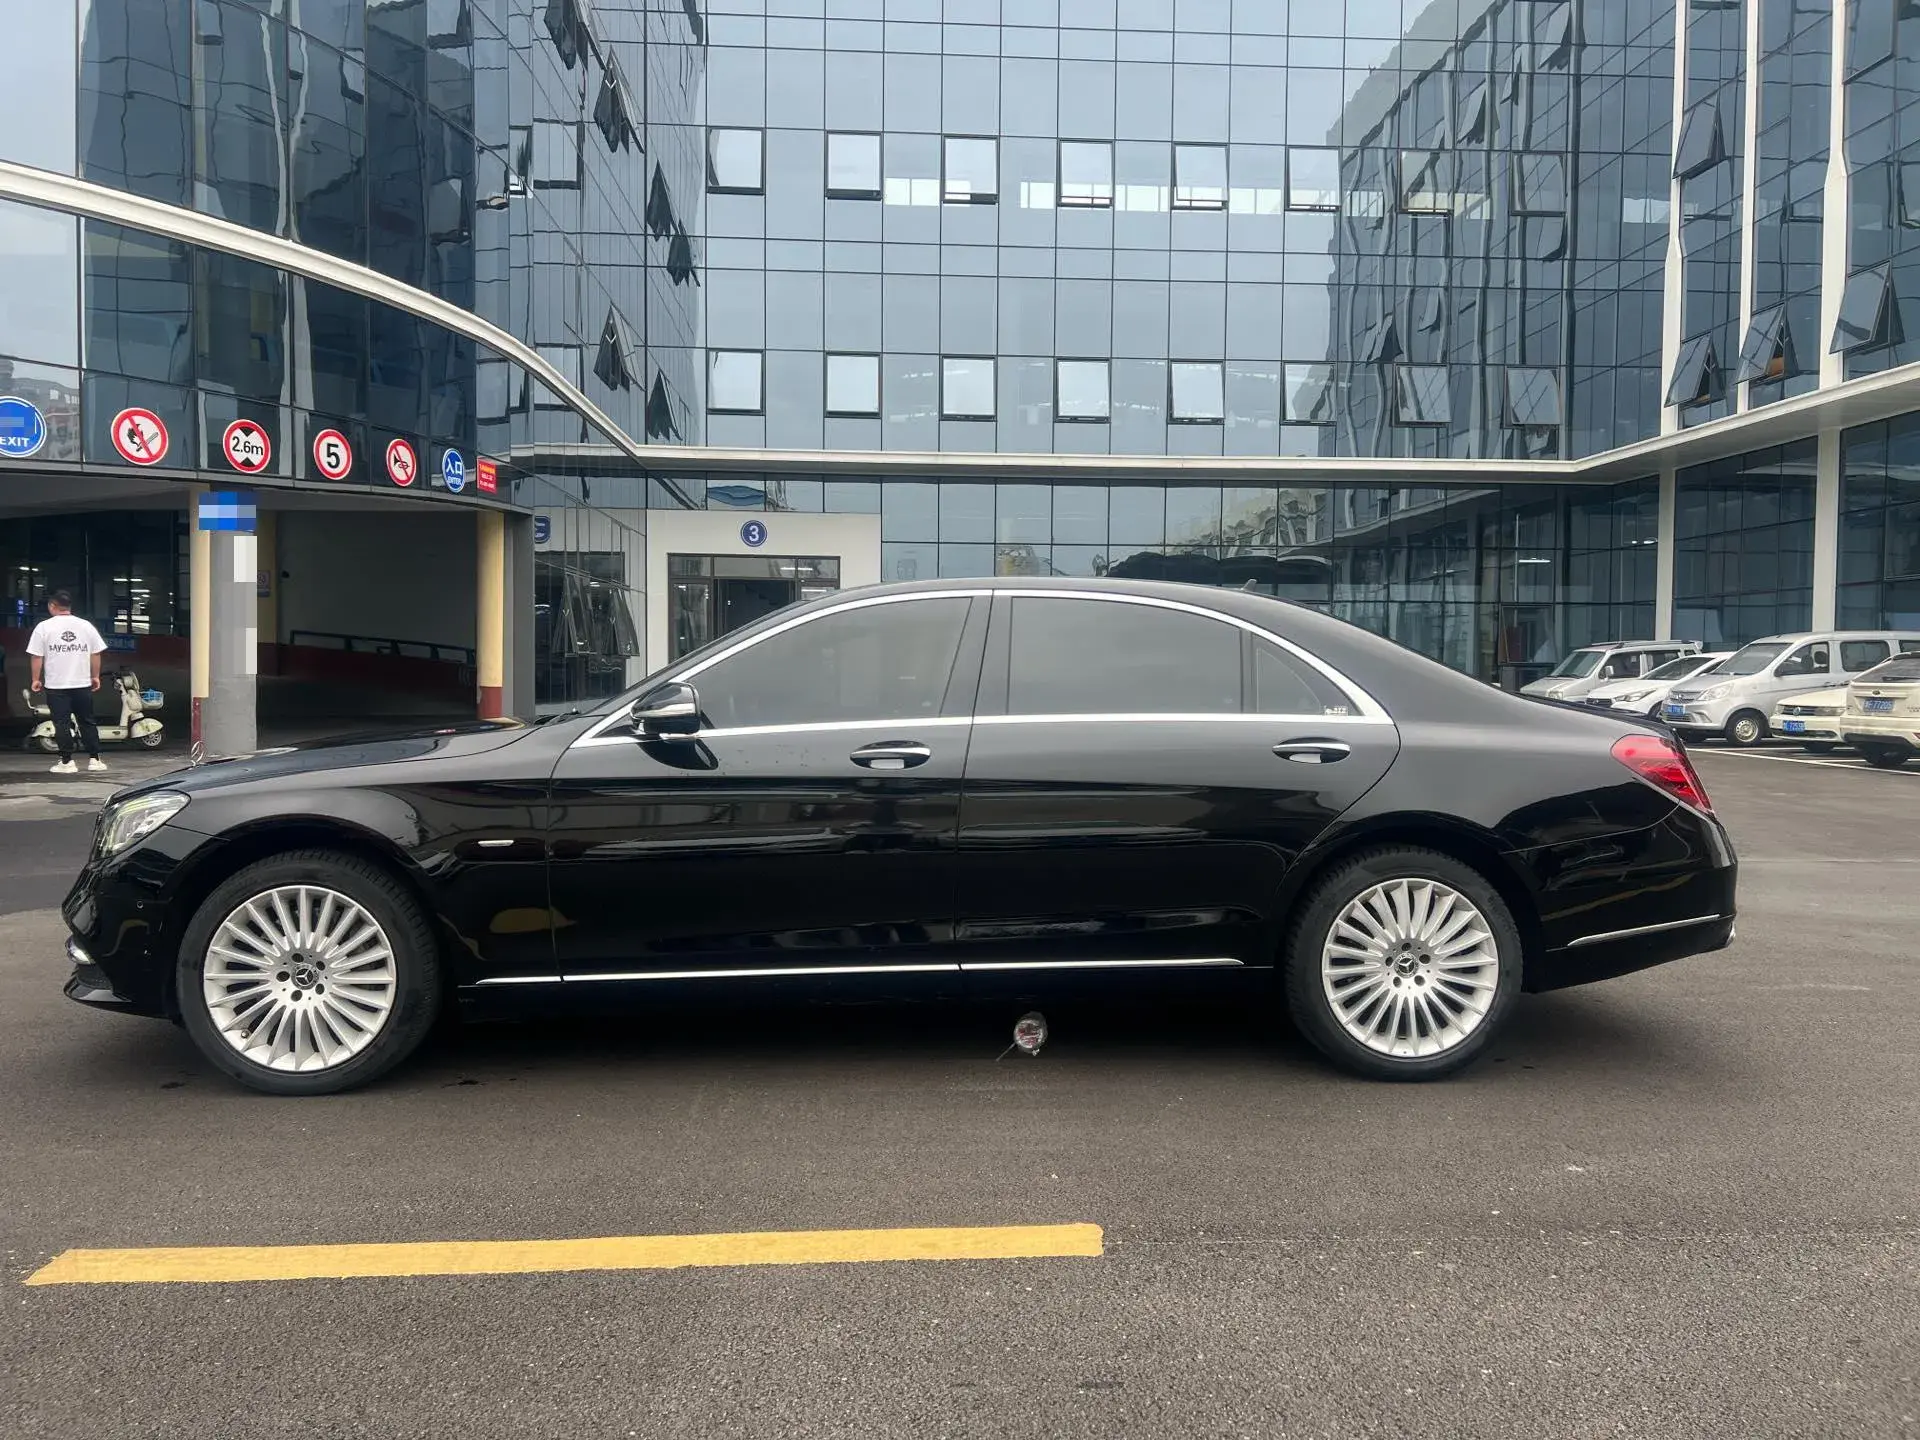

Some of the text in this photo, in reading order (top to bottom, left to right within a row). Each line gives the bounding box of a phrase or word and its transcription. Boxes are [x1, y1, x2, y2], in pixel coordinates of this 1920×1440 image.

[0, 436, 30, 447] EXIT
[232, 436, 264, 456] 2.6m
[326, 443, 340, 469] 5
[446, 457, 463, 475] 入口
[748, 525, 760, 542] 3
